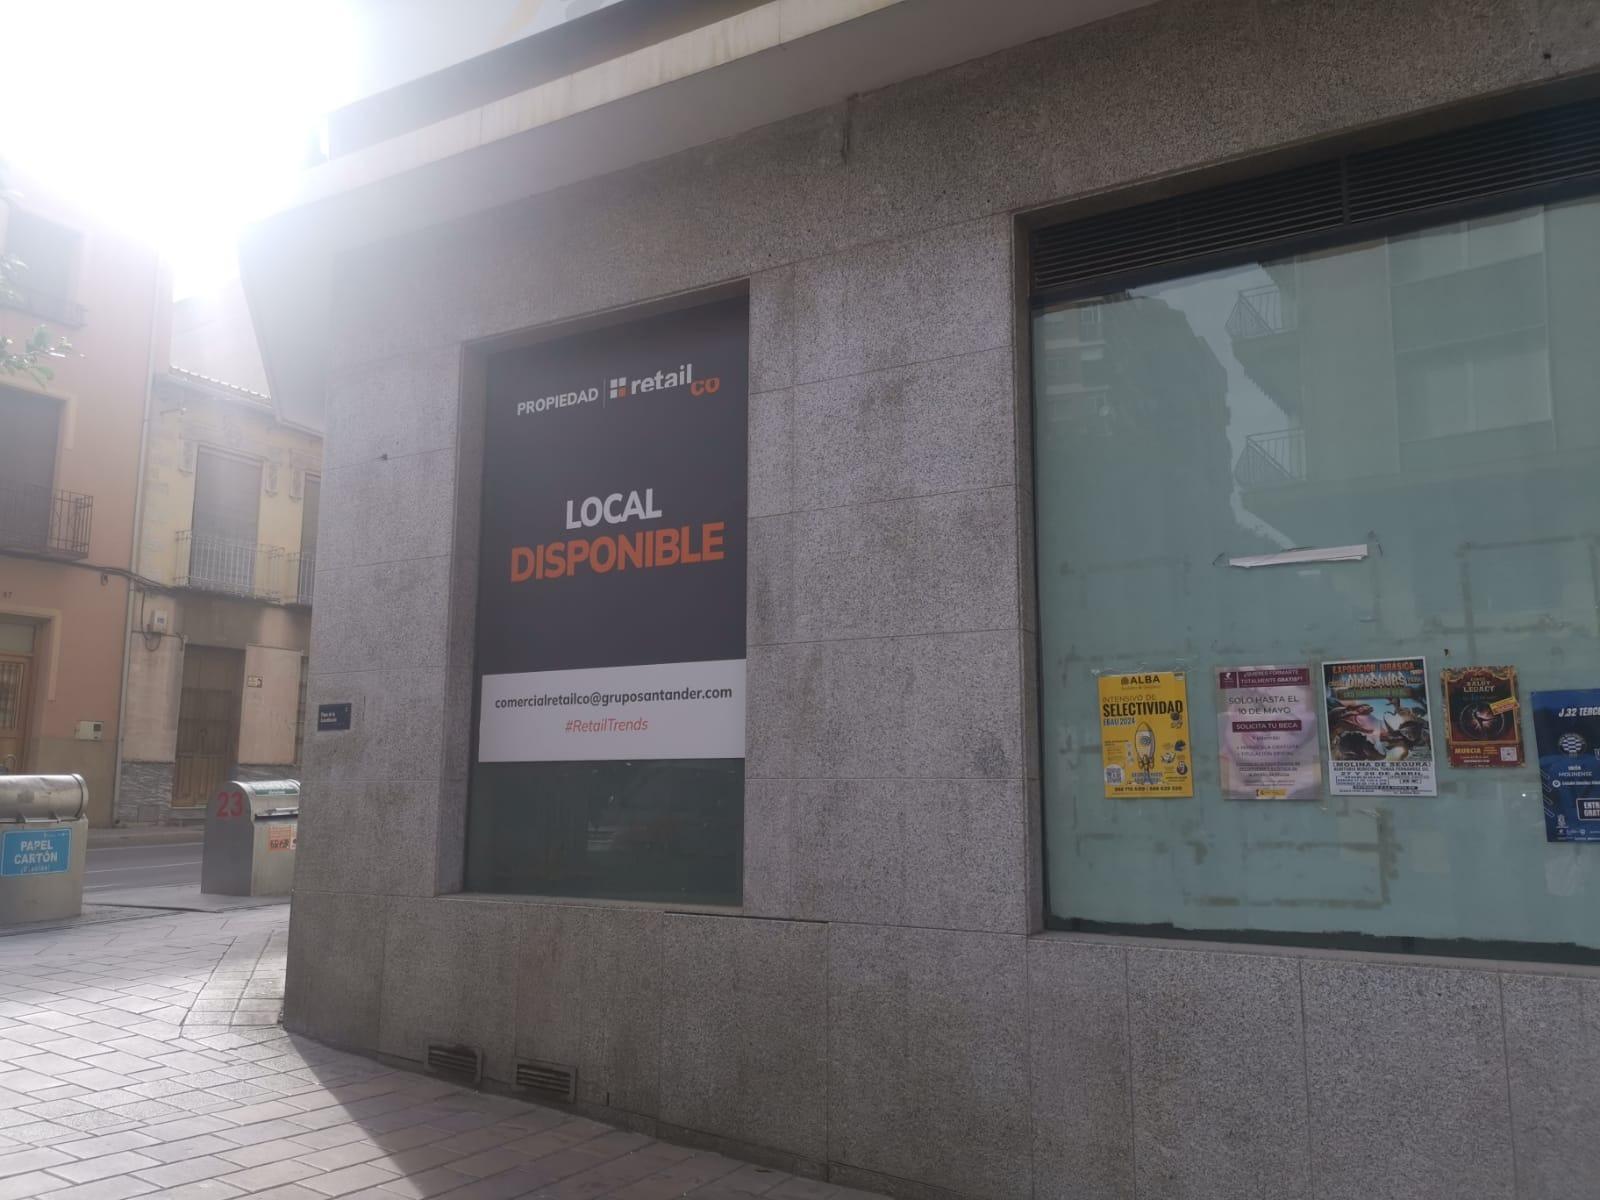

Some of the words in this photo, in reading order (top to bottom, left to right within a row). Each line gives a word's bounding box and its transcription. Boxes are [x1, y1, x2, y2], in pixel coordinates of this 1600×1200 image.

[517, 387, 599, 416] PROPIEDAD
[631, 363, 693, 395] retail
[566, 488, 662, 530] LOCAL
[511, 521, 725, 583] DISPONIBLE
[1130, 674, 1161, 685] ALBA
[494, 686, 733, 709] comercialretailco@gruposantander.com
[1102, 694, 1143, 703] INTENSIVO
[1146, 693, 1156, 701] DE
[1228, 696, 1254, 705] SOLO
[1255, 695, 1285, 704] HASTA
[1288, 695, 1300, 703] EL
[1103, 700, 1184, 718] SELECTIVIDAD
[1263, 706, 1292, 714] MAYO
[565, 717, 649, 734] #RetailTrends
[216, 790, 244, 818] 23
[20, 840, 54, 852] PAPEL
[14, 850, 59, 865] CARTÓN
